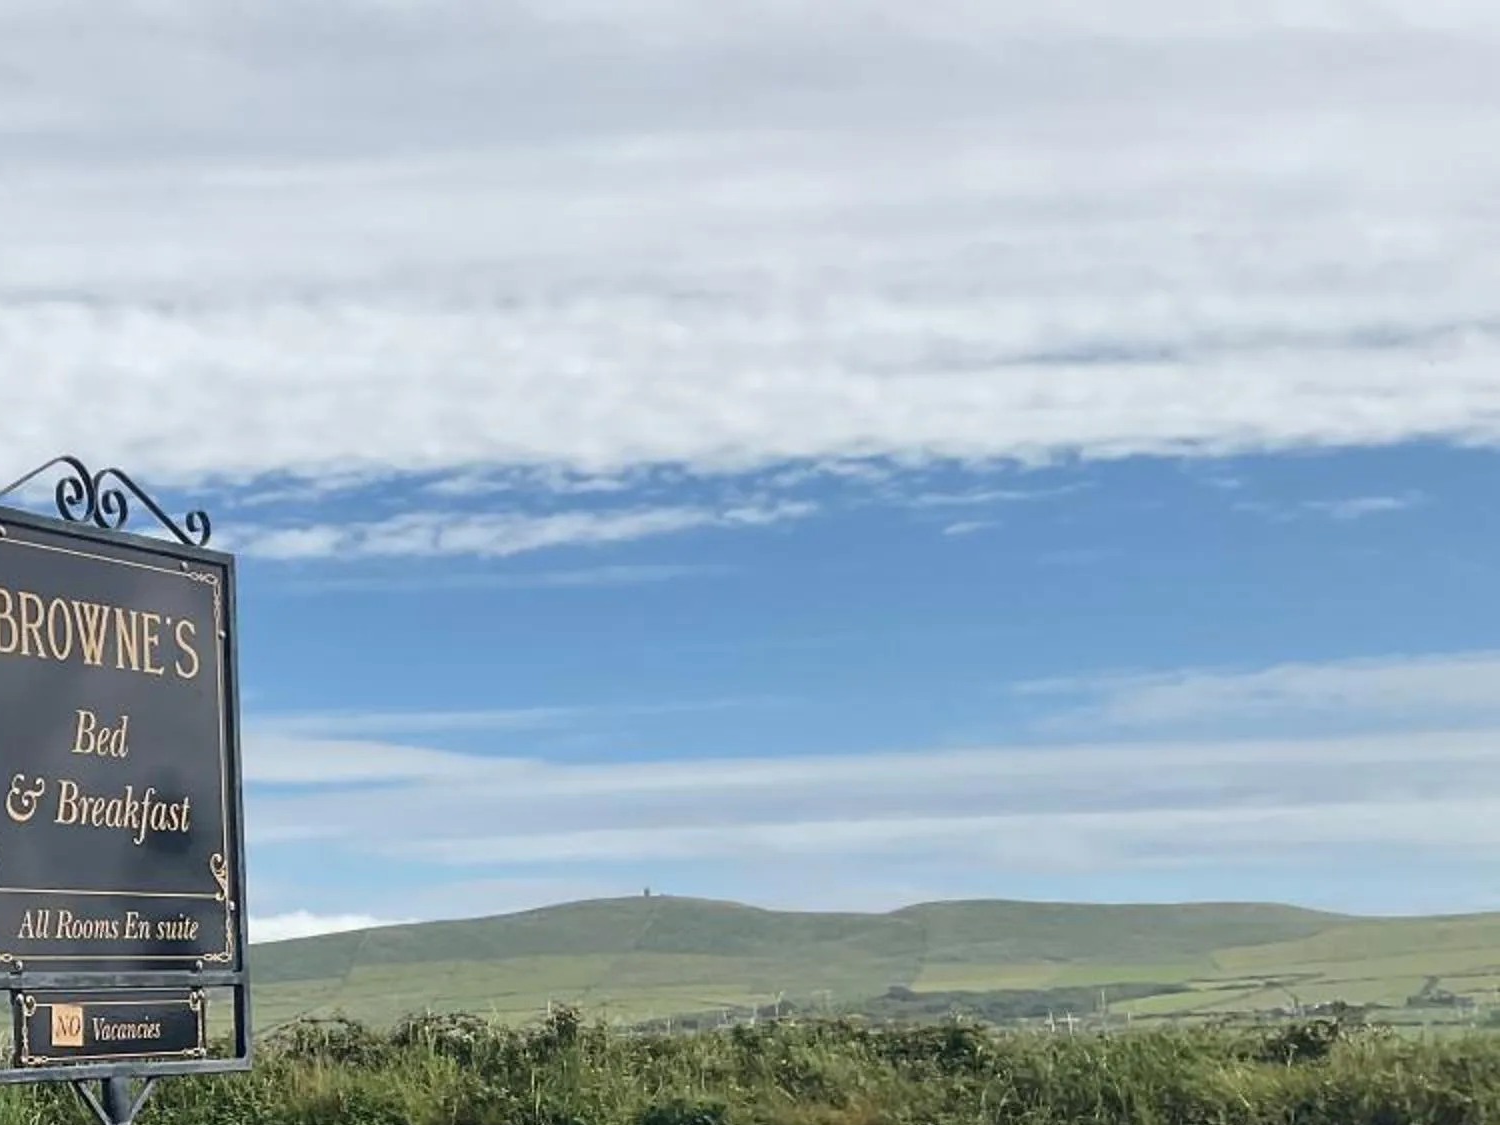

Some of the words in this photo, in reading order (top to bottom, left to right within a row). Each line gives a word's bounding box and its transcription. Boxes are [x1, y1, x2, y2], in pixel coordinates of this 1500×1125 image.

[71, 709, 129, 758] Bed
[5, 773, 45, 822] &
[55, 778, 191, 845] Breakfast
[18, 908, 49, 939] All
[56, 910, 119, 940] Rooms
[124, 911, 151, 940] En
[155, 913, 199, 940] suite
[55, 1014, 81, 1038] NO
[91, 1016, 161, 1041] Vacancies
